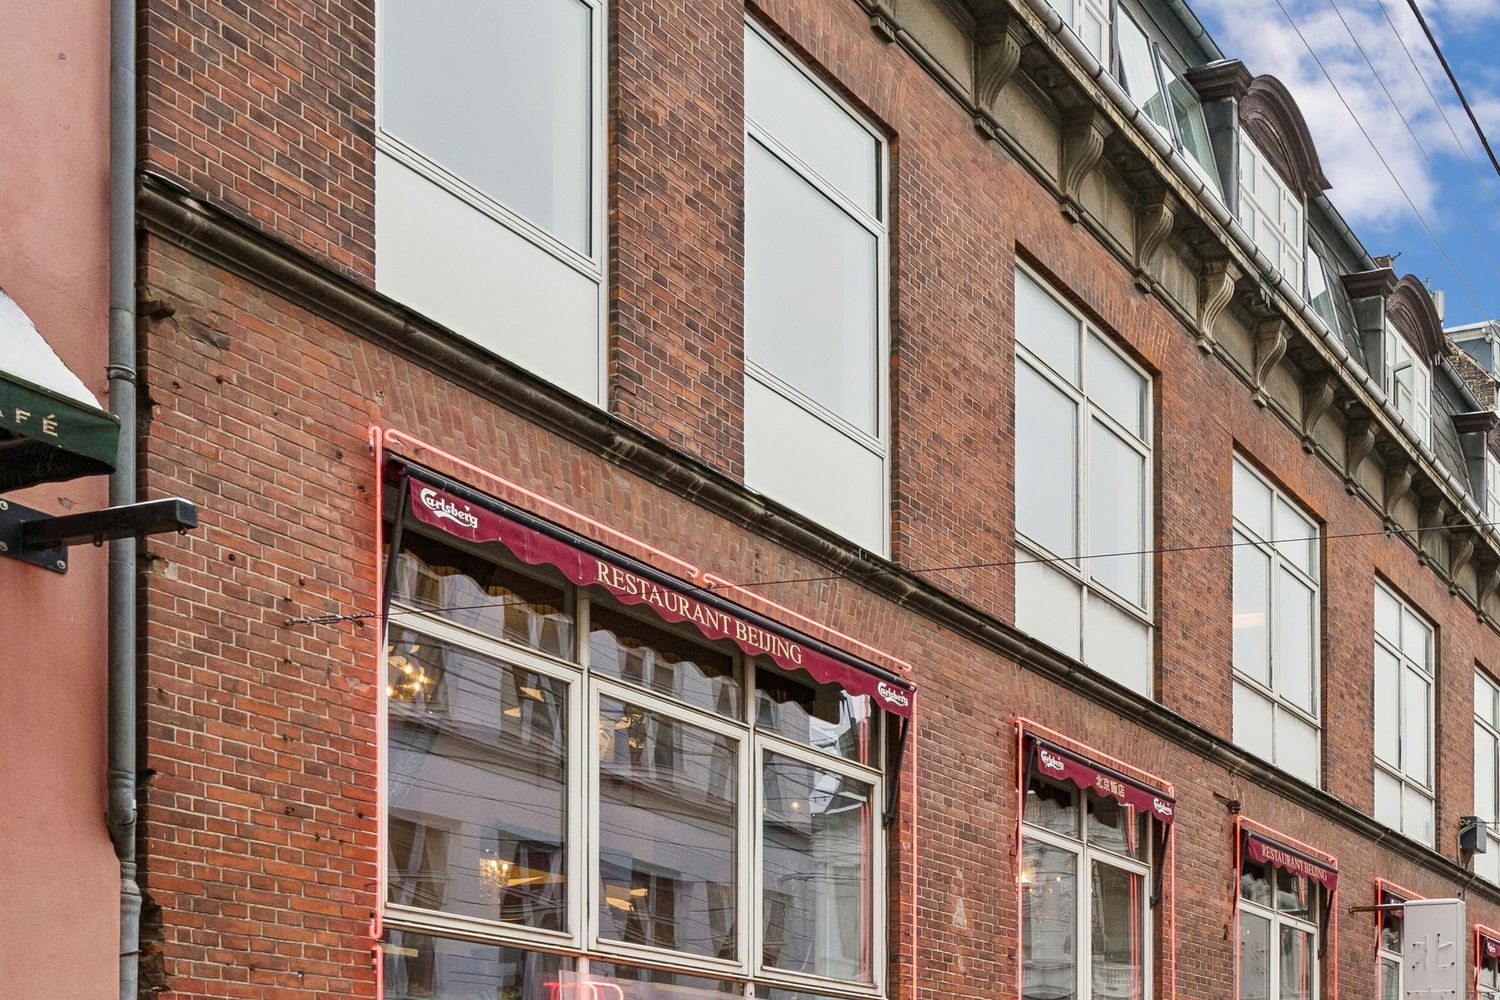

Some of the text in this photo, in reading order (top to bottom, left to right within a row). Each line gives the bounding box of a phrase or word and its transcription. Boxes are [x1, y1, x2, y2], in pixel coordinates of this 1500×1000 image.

[0, 408, 58, 437] FÉ
[420, 487, 478, 529] Carlsberg
[597, 560, 803, 665] RESTAURANT BEIJING
[877, 681, 909, 707] Carlsberg
[1261, 845, 1304, 873] RESTAURANT
